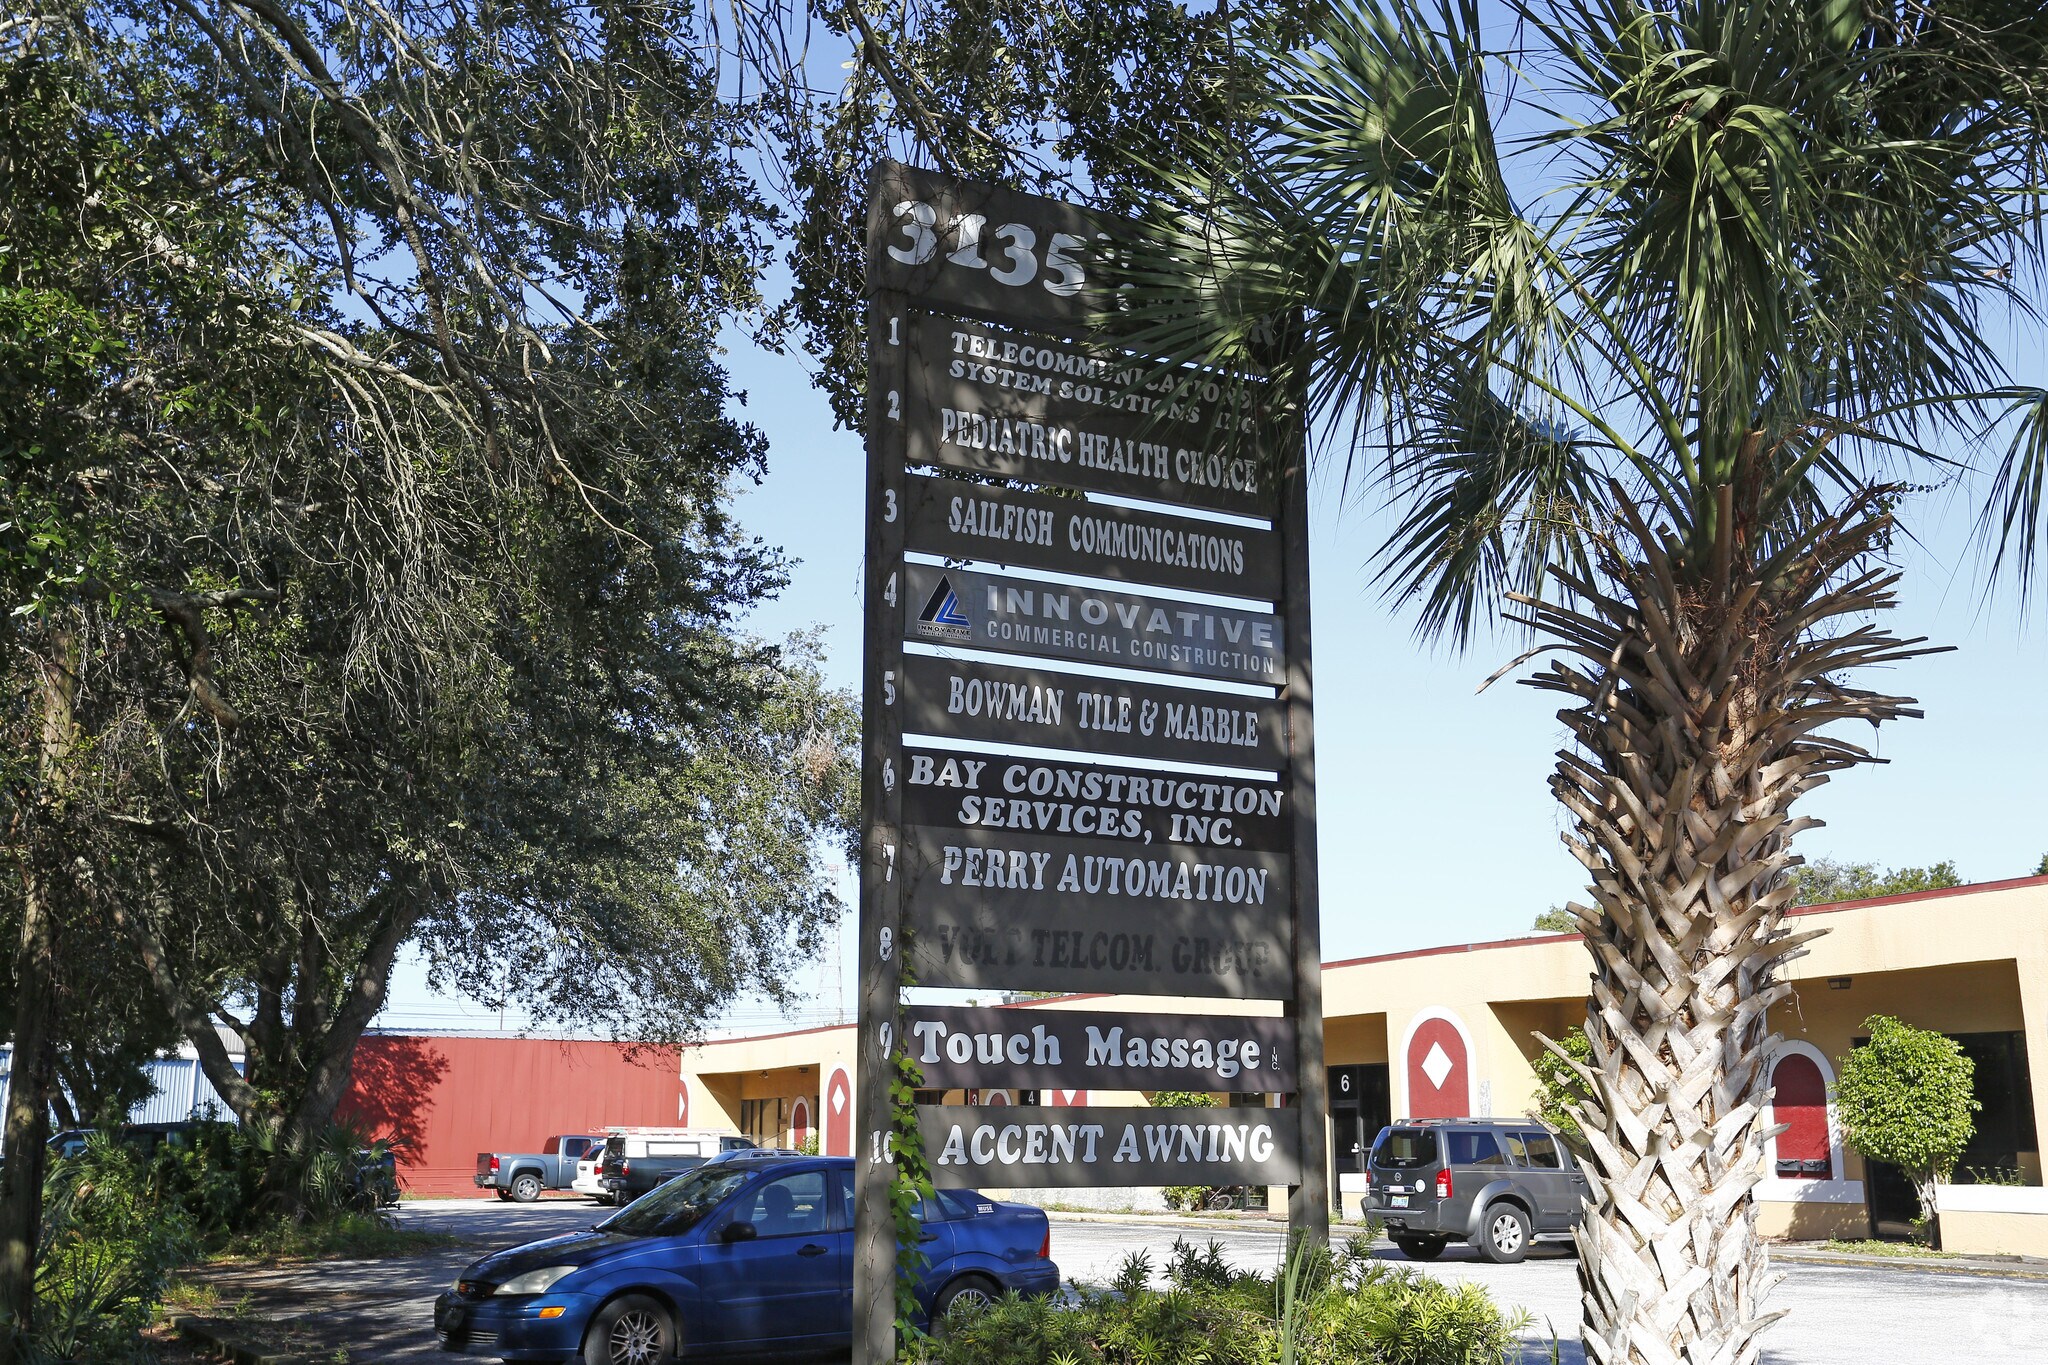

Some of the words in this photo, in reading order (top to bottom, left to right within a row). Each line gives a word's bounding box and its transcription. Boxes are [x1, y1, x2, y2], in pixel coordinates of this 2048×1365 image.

[887, 200, 1088, 297] 3135
[888, 317, 900, 346] 1
[949, 359, 1053, 395] SYSTEM
[887, 390, 900, 421] 2
[941, 407, 1072, 464] PEDIATRIC
[1078, 432, 1170, 480] HEALTH
[1175, 448, 1258, 494] CHOICE
[884, 488, 898, 523] 3
[949, 496, 1054, 546] SAILFISH
[1068, 515, 1244, 576] COMMUNICATIONS
[884, 571, 897, 608] 4
[917, 624, 971, 635] INNOVATIVE
[987, 585, 1274, 649] INNOVATIVE
[987, 620, 1121, 654] COMMERCIAL
[1130, 639, 1274, 674] CONSTRUCTION
[884, 670, 896, 706] 5
[948, 675, 1064, 726] BOWMAN
[1077, 691, 1132, 734] TILE
[1139, 698, 1159, 737] &
[1164, 702, 1259, 748] MARBLE
[883, 757, 895, 792] 6
[908, 755, 987, 789] BAY
[1002, 764, 1284, 817] CONSTRUCTION
[958, 795, 1153, 845] SERVICES,
[1168, 813, 1243, 847] INC.
[882, 843, 896, 882] 7
[940, 845, 1051, 891] PERRY
[1056, 853, 1268, 905] AUTOMATION
[879, 926, 893, 961] 8
[879, 1021, 893, 1061] 9
[913, 1020, 1063, 1065] Touch
[1085, 1025, 1261, 1078] Massage
[1028, 1090, 1035, 1105] 4
[1341, 1074, 1350, 1092] 6
[937, 1124, 1104, 1165] ACCENT
[1112, 1123, 1275, 1163] AWNING
